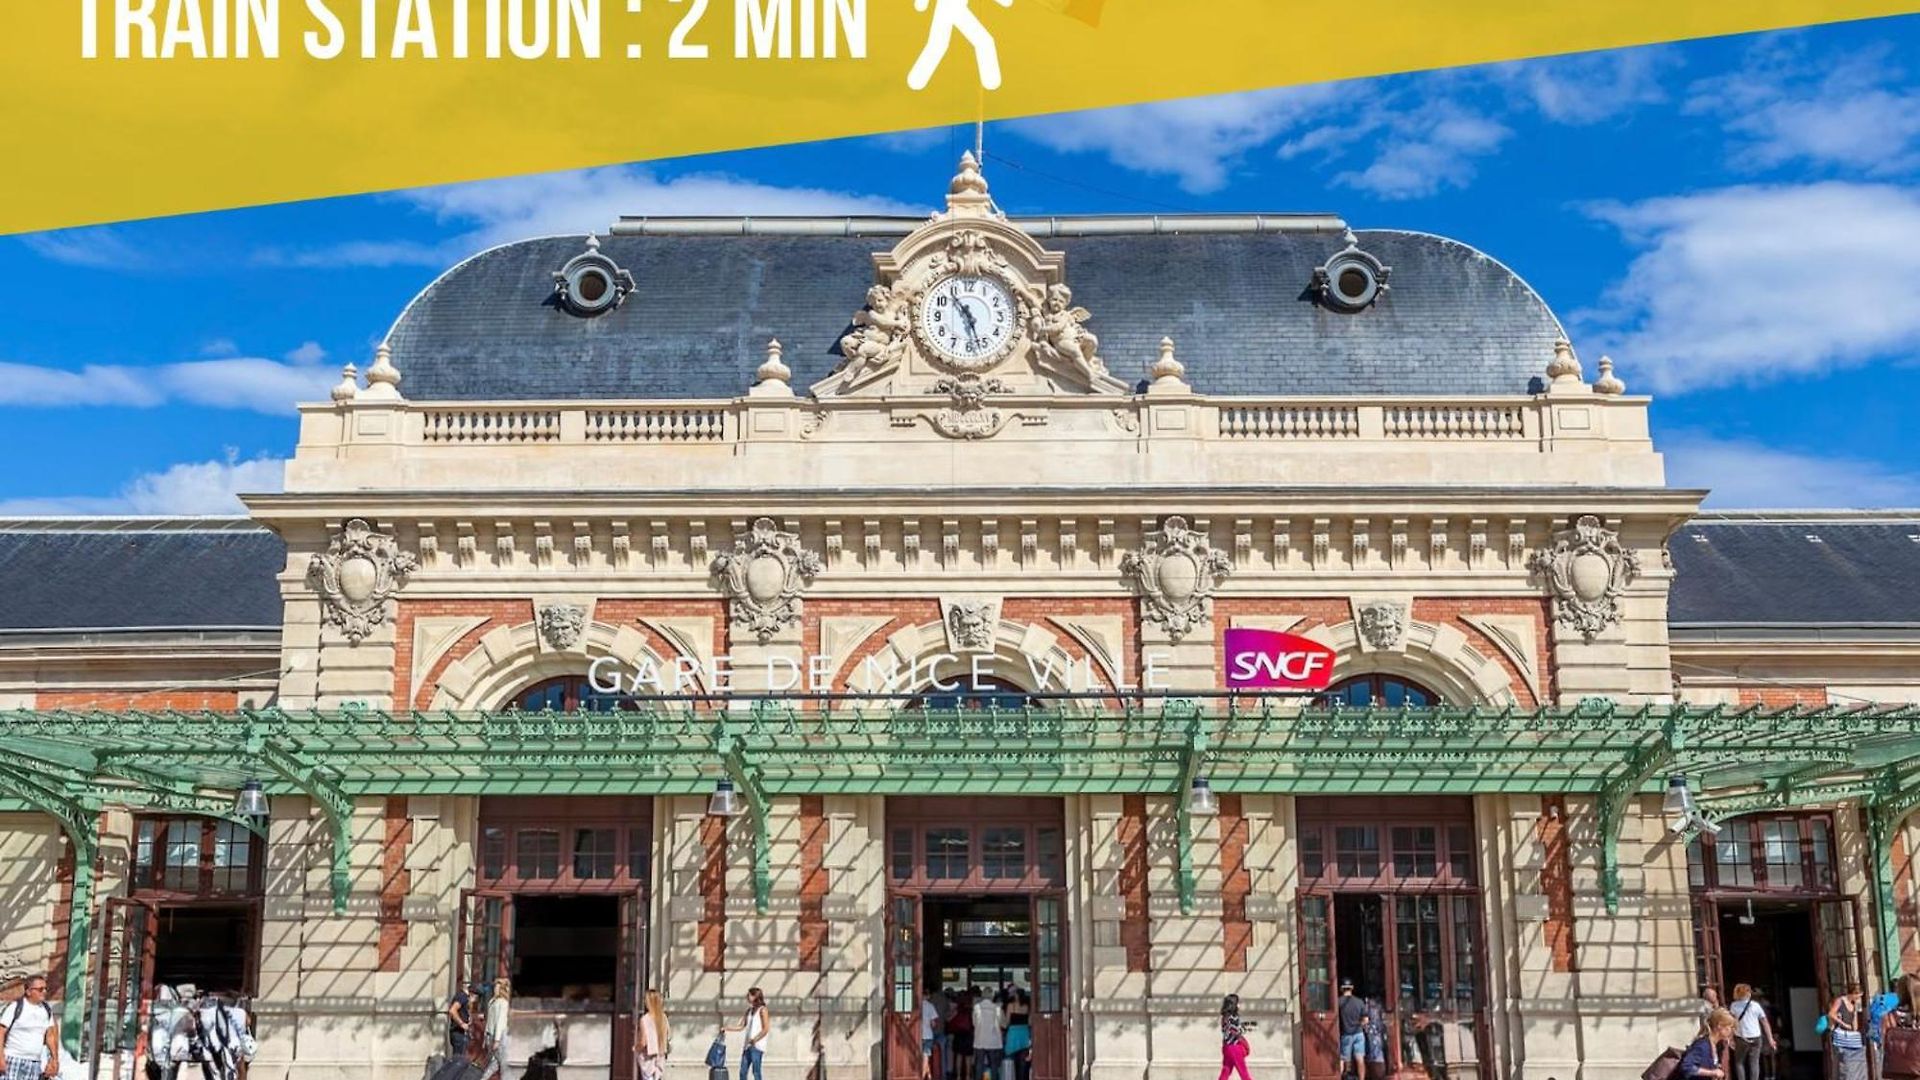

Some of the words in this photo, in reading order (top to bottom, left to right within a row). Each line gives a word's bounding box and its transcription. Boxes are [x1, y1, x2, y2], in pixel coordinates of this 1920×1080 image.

[963, 281, 975, 292] 12
[937, 296, 947, 306] 10
[992, 297, 999, 308] 2
[934, 311, 941, 322] 9
[996, 311, 1004, 322] 3
[938, 326, 945, 337] 8
[992, 328, 999, 336] 4
[950, 337, 957, 349] 7
[1230, 651, 1330, 681] SNCF
[588, 655, 735, 693] GARE
[766, 654, 835, 692] DE
[865, 653, 997, 691] NICE
[1026, 652, 1173, 690] VILLE
